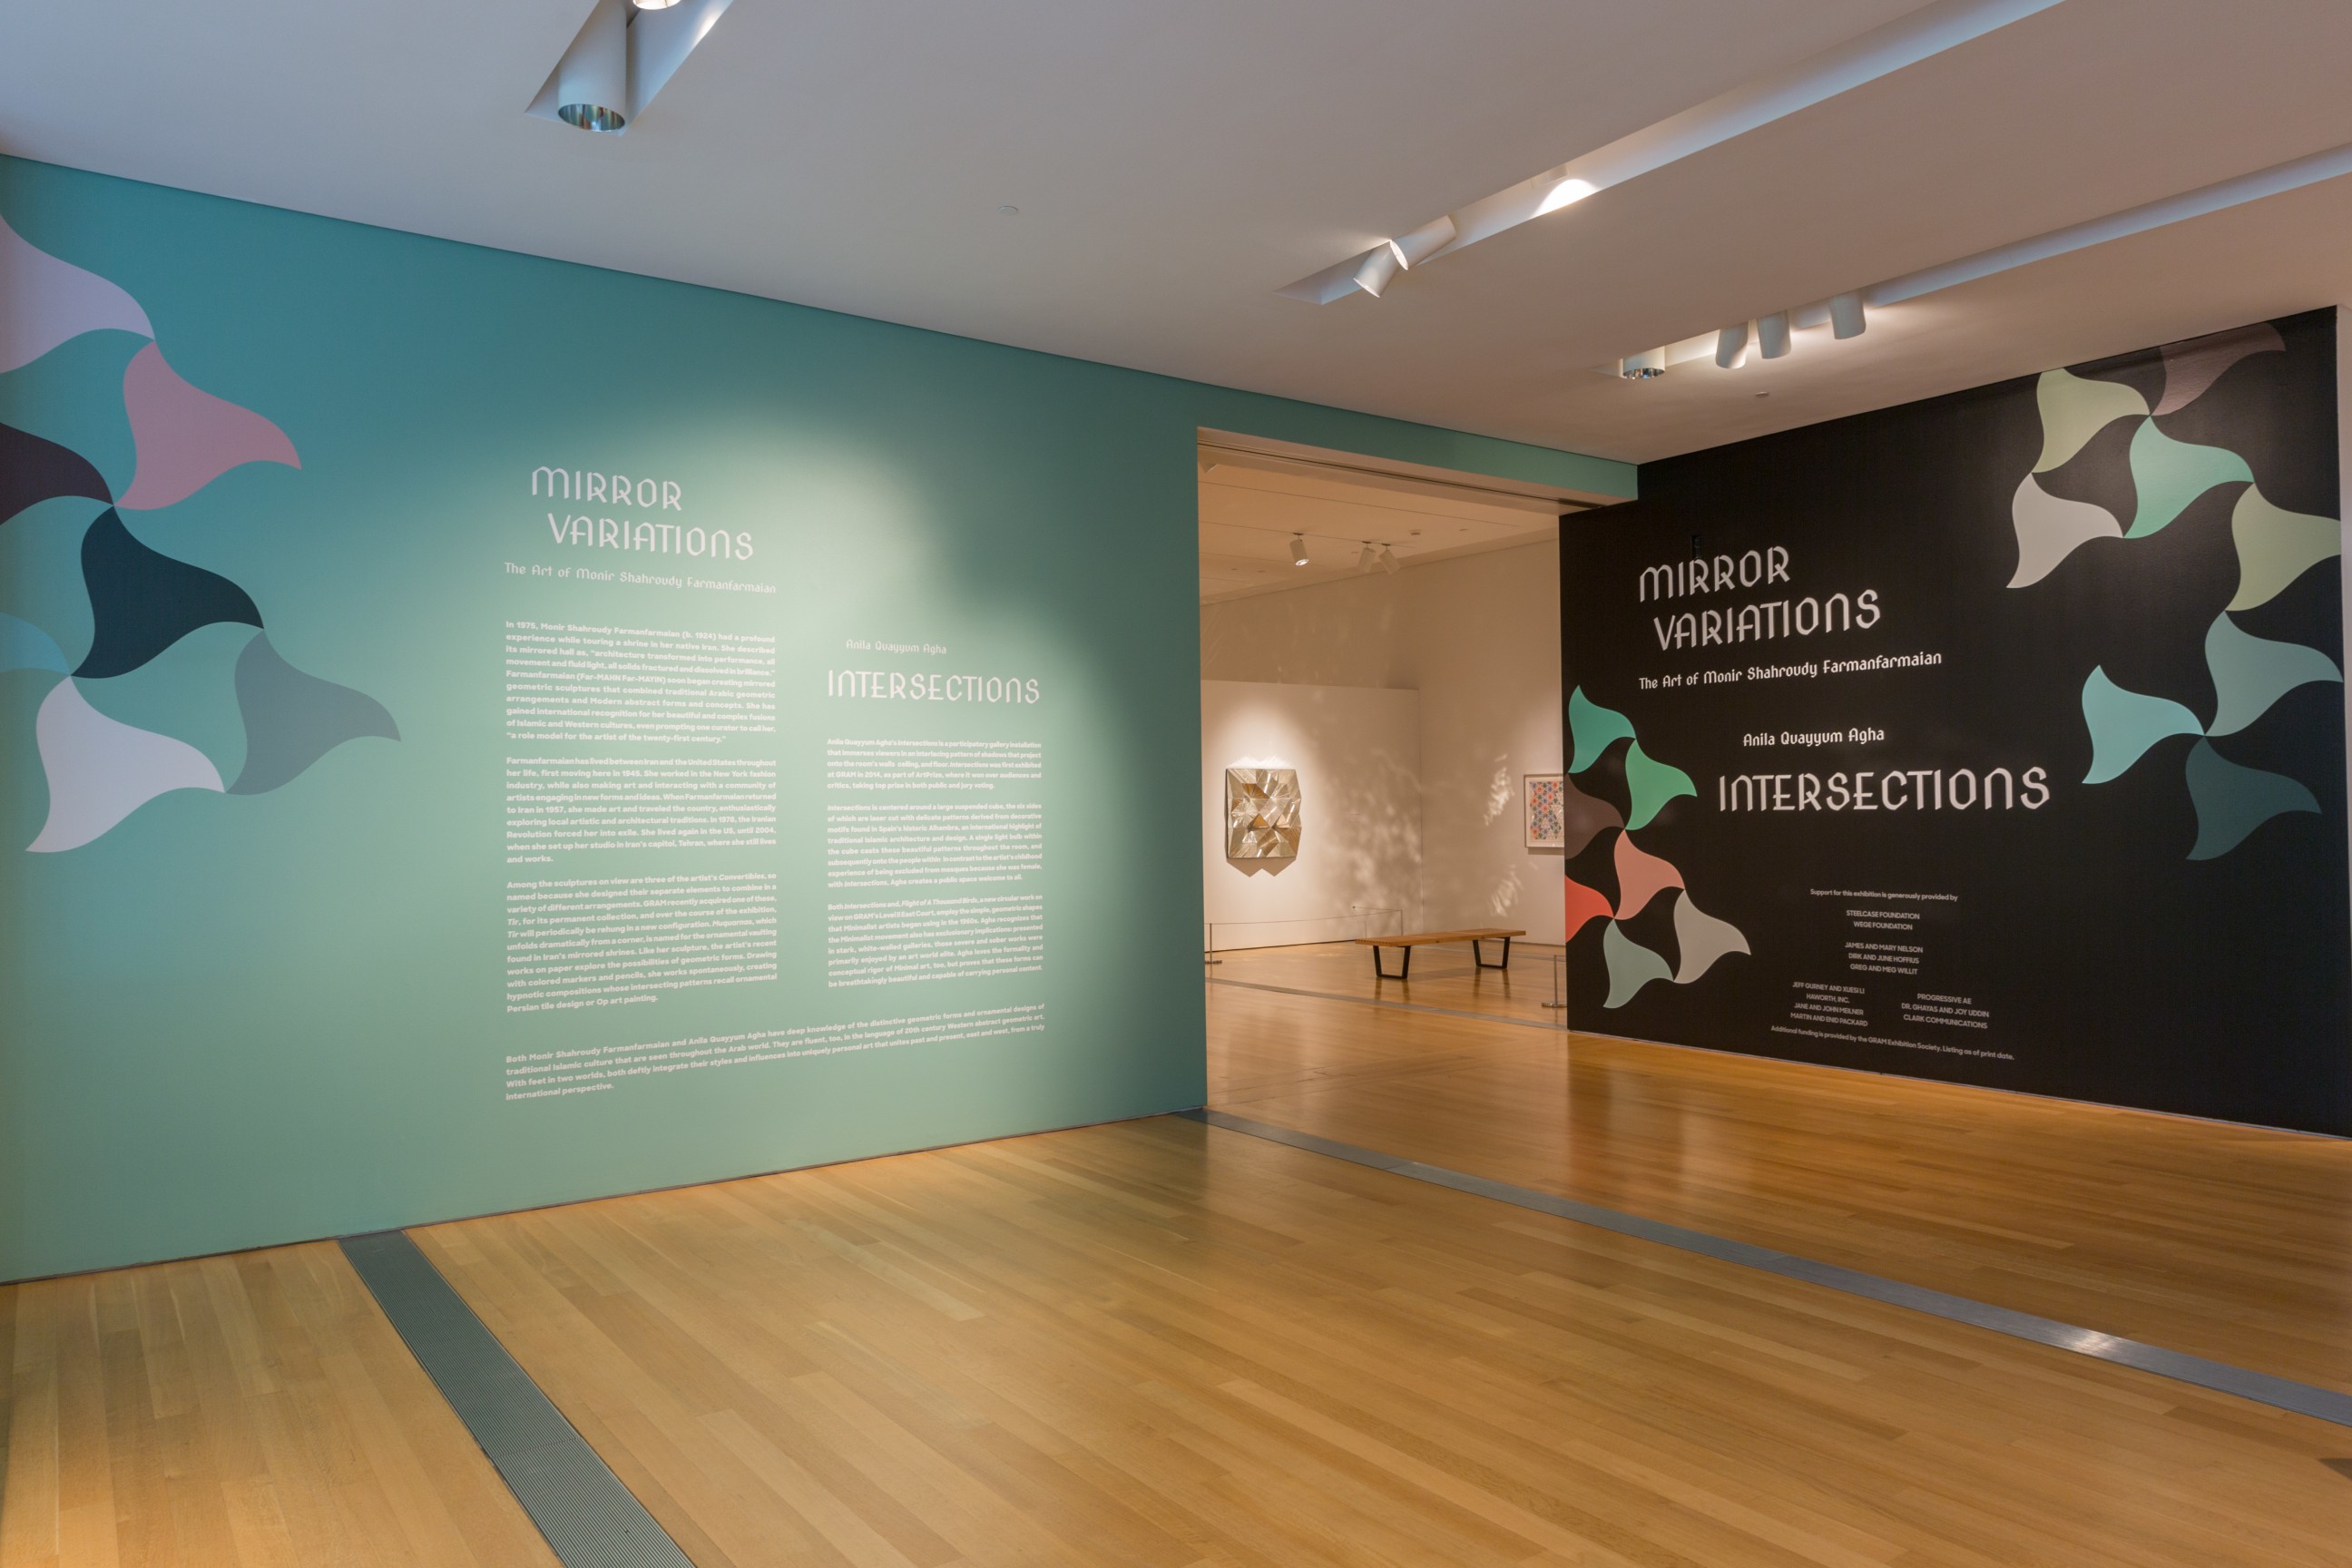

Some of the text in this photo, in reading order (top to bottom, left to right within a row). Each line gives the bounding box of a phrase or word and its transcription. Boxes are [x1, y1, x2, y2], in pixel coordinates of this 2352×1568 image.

[532, 466, 682, 512] MIRROR
[547, 512, 753, 561] VARIATIONS
[504, 562, 776, 593] The Art of Monir Shahroudy Farmanfarmaian
[1639, 545, 1790, 603] MIRROR
[1653, 589, 1882, 652] VARIATIONS
[567, 624, 612, 635] Shahroudy
[614, 627, 680, 637] Farmanfarmaian
[695, 632, 717, 640] 1924)
[846, 639, 947, 655] Anila Quayyum Agha
[1639, 652, 1942, 689] The Art of Monir Shahroudy Farmanfarmaian
[554, 684, 601, 693] sculptures
[736, 690, 775, 699] geometric
[828, 669, 1040, 704] INTERSECTIONS
[643, 734, 690, 742] twenty-first
[1743, 727, 1885, 746] Anila Quayyum Agha
[852, 782, 874, 790] taking
[1719, 766, 2051, 812] INTERSECTIONS
[677, 828, 699, 836] again
[1949, 894, 1958, 902] by
[1872, 922, 1913, 930] FOUNDATION
[506, 1004, 540, 1012] Persian
[556, 1000, 584, 1008] design
[596, 998, 609, 1006] Op
[623, 994, 658, 1004] painting.
[1917, 993, 1962, 1003] PROGRESSIVE
[1912, 1004, 1939, 1012] GHAYAS
[1838, 1017, 1869, 1026] PACKARD
[1903, 1014, 1988, 1028] CLARK COMMUNICATIONS
[1771, 1025, 1798, 1034] Additional
[1798, 1028, 1819, 1038] funding
[1887, 1039, 1917, 1048] Exhibition
[1942, 1045, 1964, 1055] Listing
[506, 1083, 614, 1100] international perspective.
